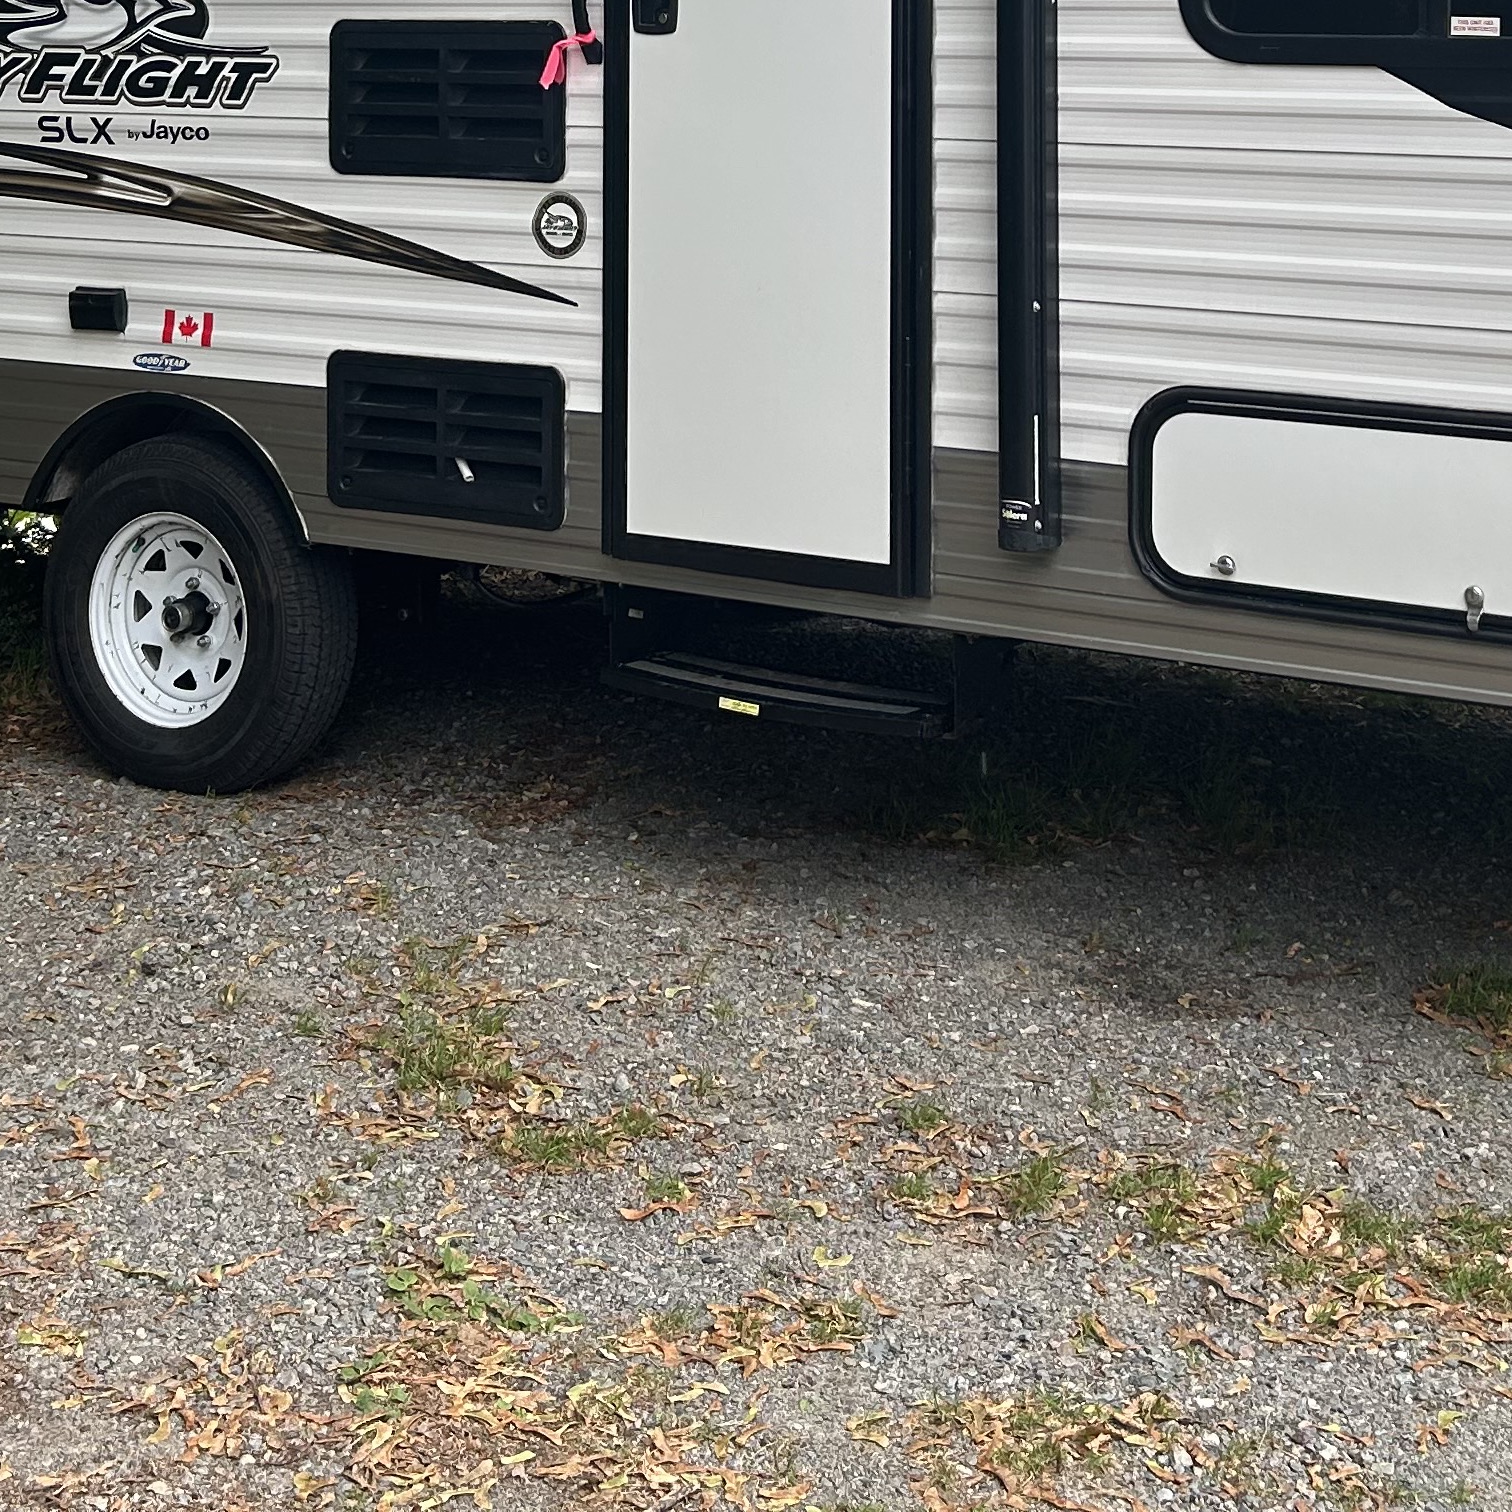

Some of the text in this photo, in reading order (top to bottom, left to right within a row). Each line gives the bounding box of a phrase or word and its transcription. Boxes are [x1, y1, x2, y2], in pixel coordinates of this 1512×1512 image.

[18, 45, 280, 109] FLIGHT
[37, 115, 210, 145] SLX by Jayco
